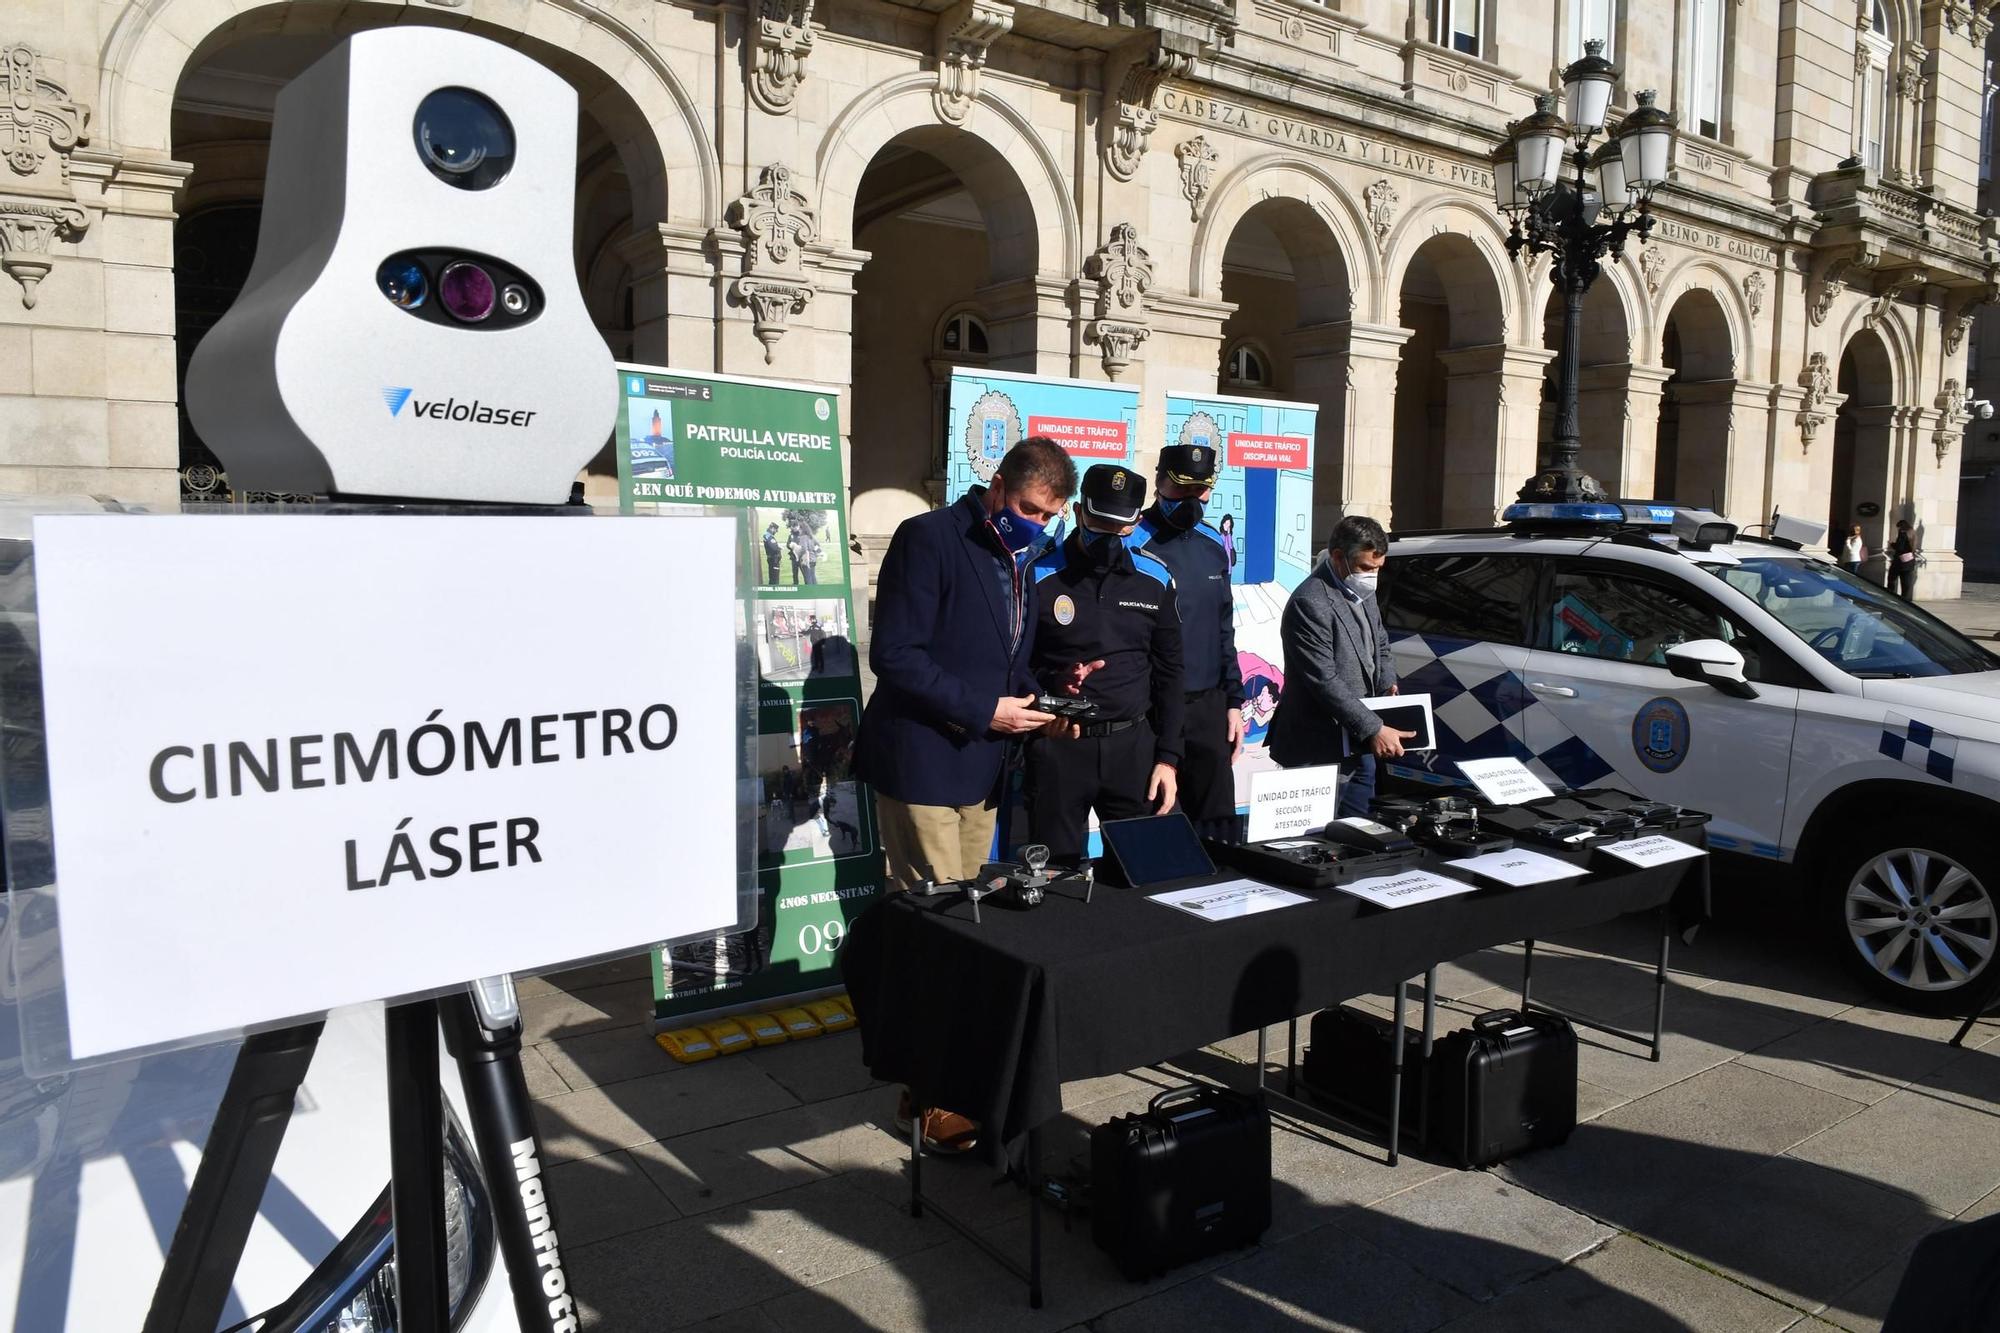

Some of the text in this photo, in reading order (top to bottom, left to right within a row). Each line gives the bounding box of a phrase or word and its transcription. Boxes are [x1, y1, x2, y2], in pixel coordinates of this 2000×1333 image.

[1164, 93, 1249, 129] CABEZA
[1267, 119, 1347, 153] GVARDA
[1360, 141, 1370, 158] Y
[1382, 148, 1435, 175] LLAVE
[1661, 222, 1771, 263] REINO DE GALICIA
[414, 398, 536, 427] velolaser
[687, 424, 832, 450] PATRULLA VERDE
[1038, 423, 1119, 437] UNIDADE DE TRÁFICO
[1052, 438, 1123, 451] TADOS DE TRÁFICO
[1235, 439, 1301, 452] UNIDADE DE TRÁFICO
[721, 446, 804, 463] POLICÍA LOCAL
[1244, 452, 1293, 463] DISCIPLINA VIAL
[633, 483, 836, 504] ¿EN QUÉ PODEMOS AYUDARTE?
[149, 703, 678, 804] CINEMÓMETRO
[1257, 785, 1331, 803] UNIDAD DE TRÁFICO
[1304, 804, 1312, 812] DE
[1275, 818, 1311, 830] ATESTADOS
[345, 817, 542, 891] LÁSER
[780, 884, 875, 909] ¿NOS NECESITAS?
